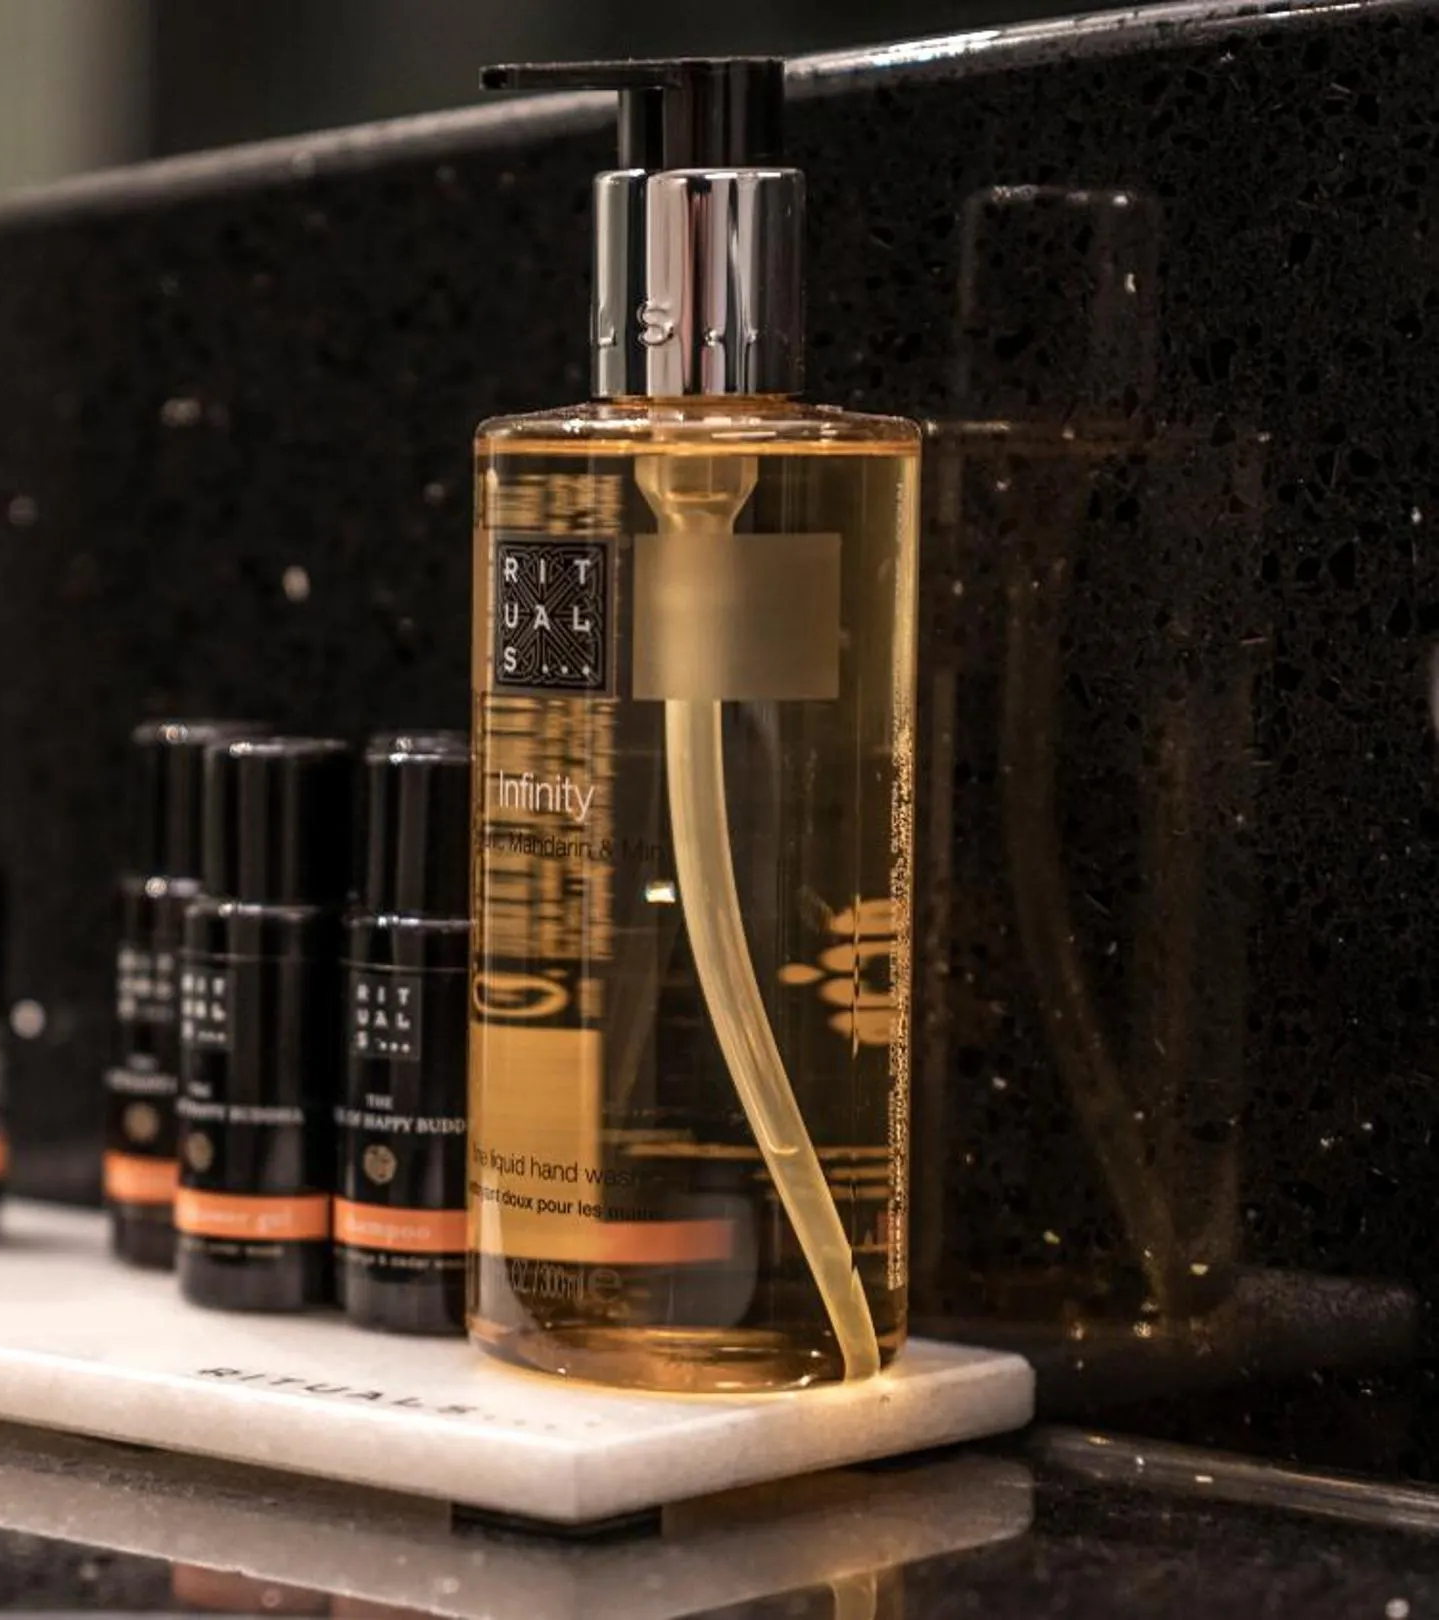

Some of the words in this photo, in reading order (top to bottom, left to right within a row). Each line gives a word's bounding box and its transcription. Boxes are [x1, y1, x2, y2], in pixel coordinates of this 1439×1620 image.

[498, 768, 596, 823] Infinity
[365, 1093, 394, 1111] THE
[363, 1111, 414, 1133] HAPPY
[415, 1116, 467, 1135] BUDD
[490, 1147, 526, 1177] liquid
[530, 1155, 579, 1184] hand
[536, 1197, 574, 1215] pour
[578, 1200, 602, 1218] les
